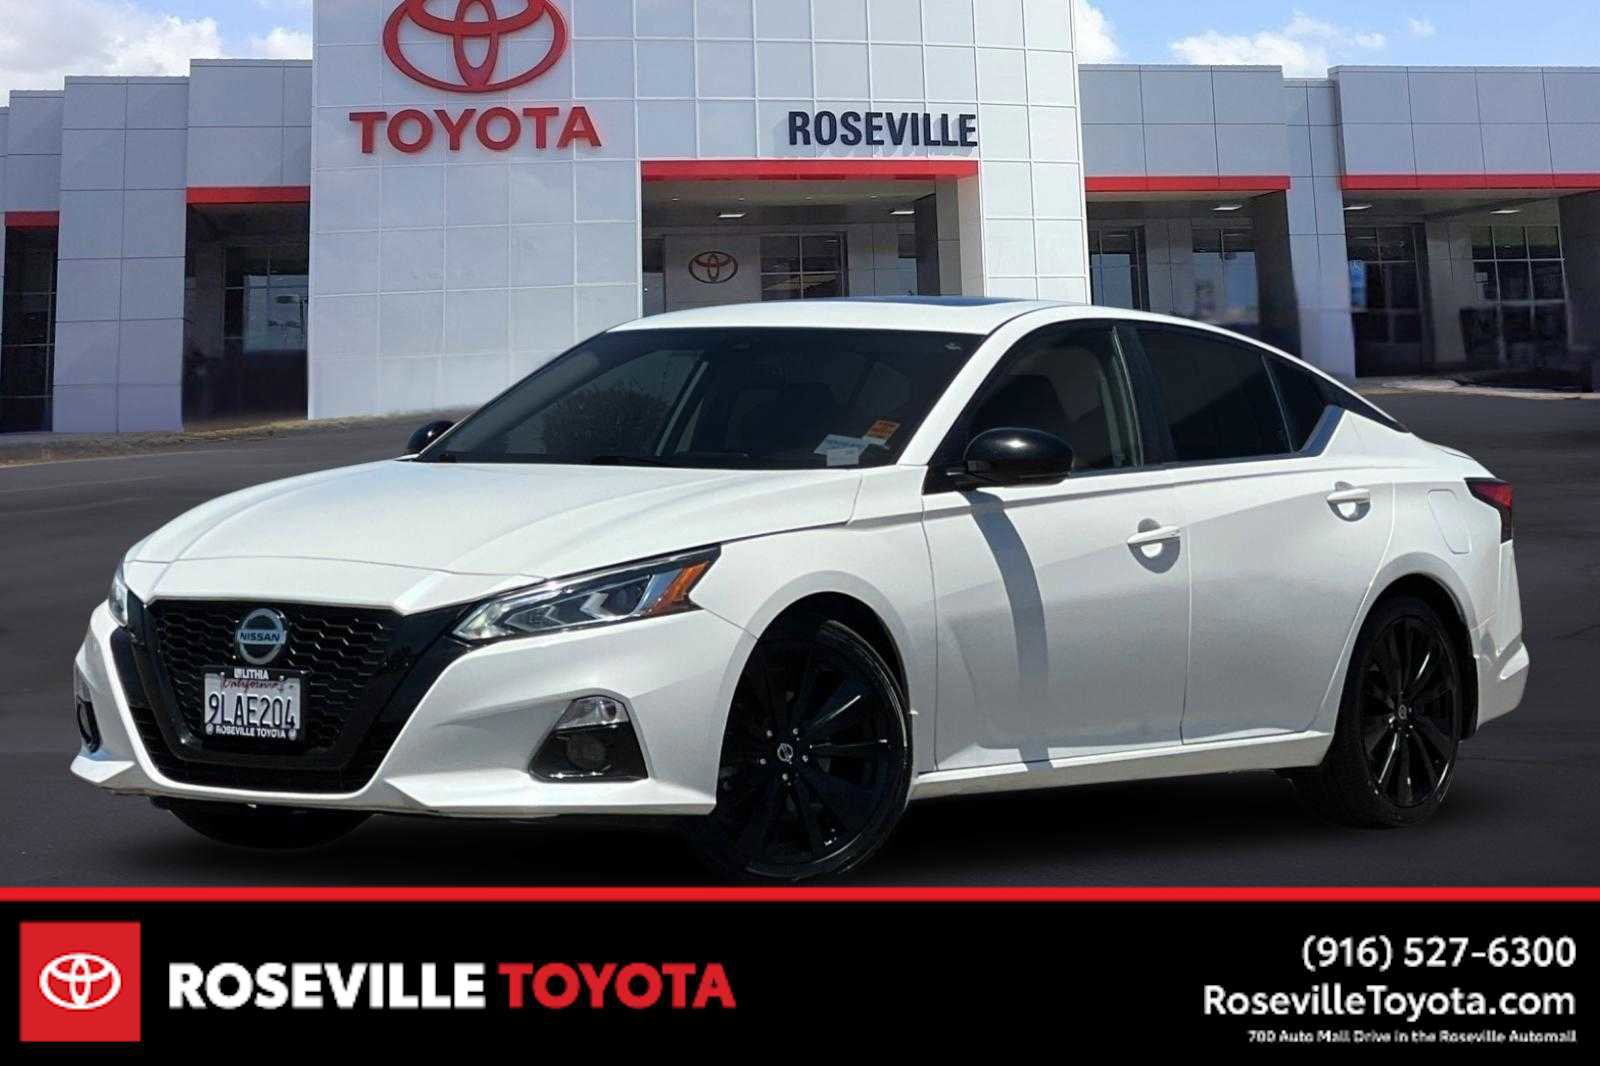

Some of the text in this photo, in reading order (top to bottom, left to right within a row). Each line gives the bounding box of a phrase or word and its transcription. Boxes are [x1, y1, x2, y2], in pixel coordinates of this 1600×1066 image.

[349, 105, 602, 154] TOYOTA
[788, 110, 978, 147] ROSEVILLE
[240, 632, 280, 642] NISSAN
[208, 692, 296, 729] 9LAE204
[215, 725, 286, 739] ROSEVILLE TOYOTA
